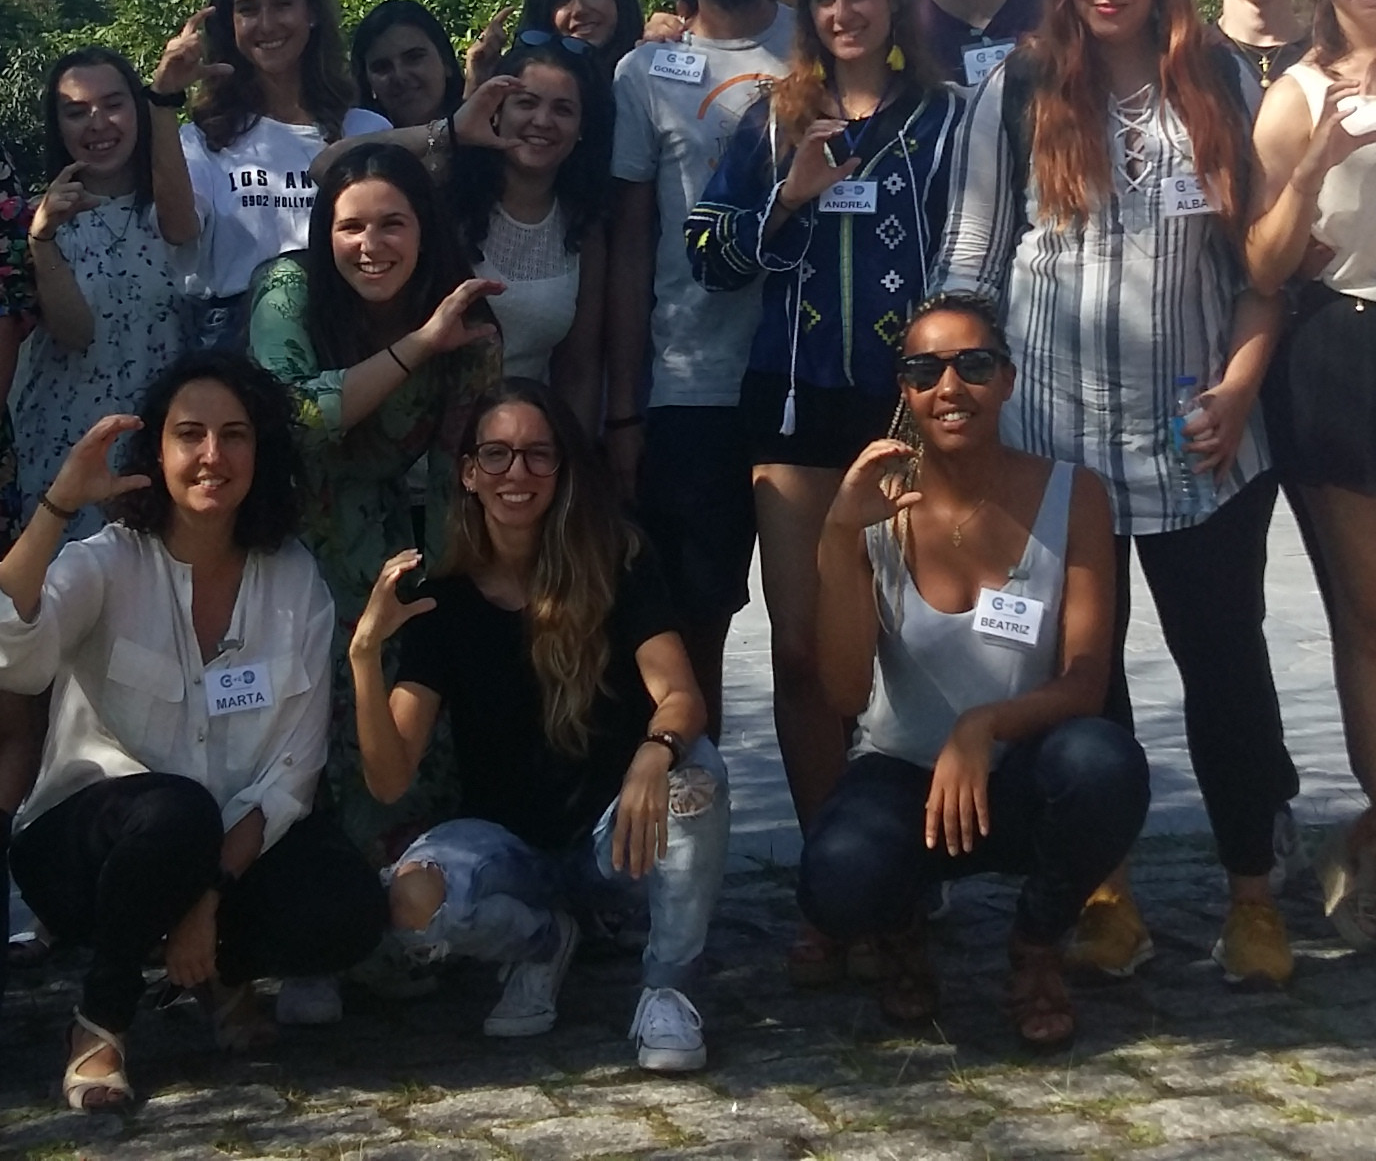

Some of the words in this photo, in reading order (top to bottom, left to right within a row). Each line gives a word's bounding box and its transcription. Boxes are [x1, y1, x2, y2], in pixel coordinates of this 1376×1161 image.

[653, 64, 701, 78] GONZALO
[228, 169, 268, 192] LOS
[285, 170, 313, 189] AN
[242, 194, 269, 207] 6902
[824, 200, 871, 209] ANDREA
[1176, 198, 1209, 211] ALBA
[980, 616, 1031, 636] BEATRIZ
[216, 691, 265, 711] MARTA
